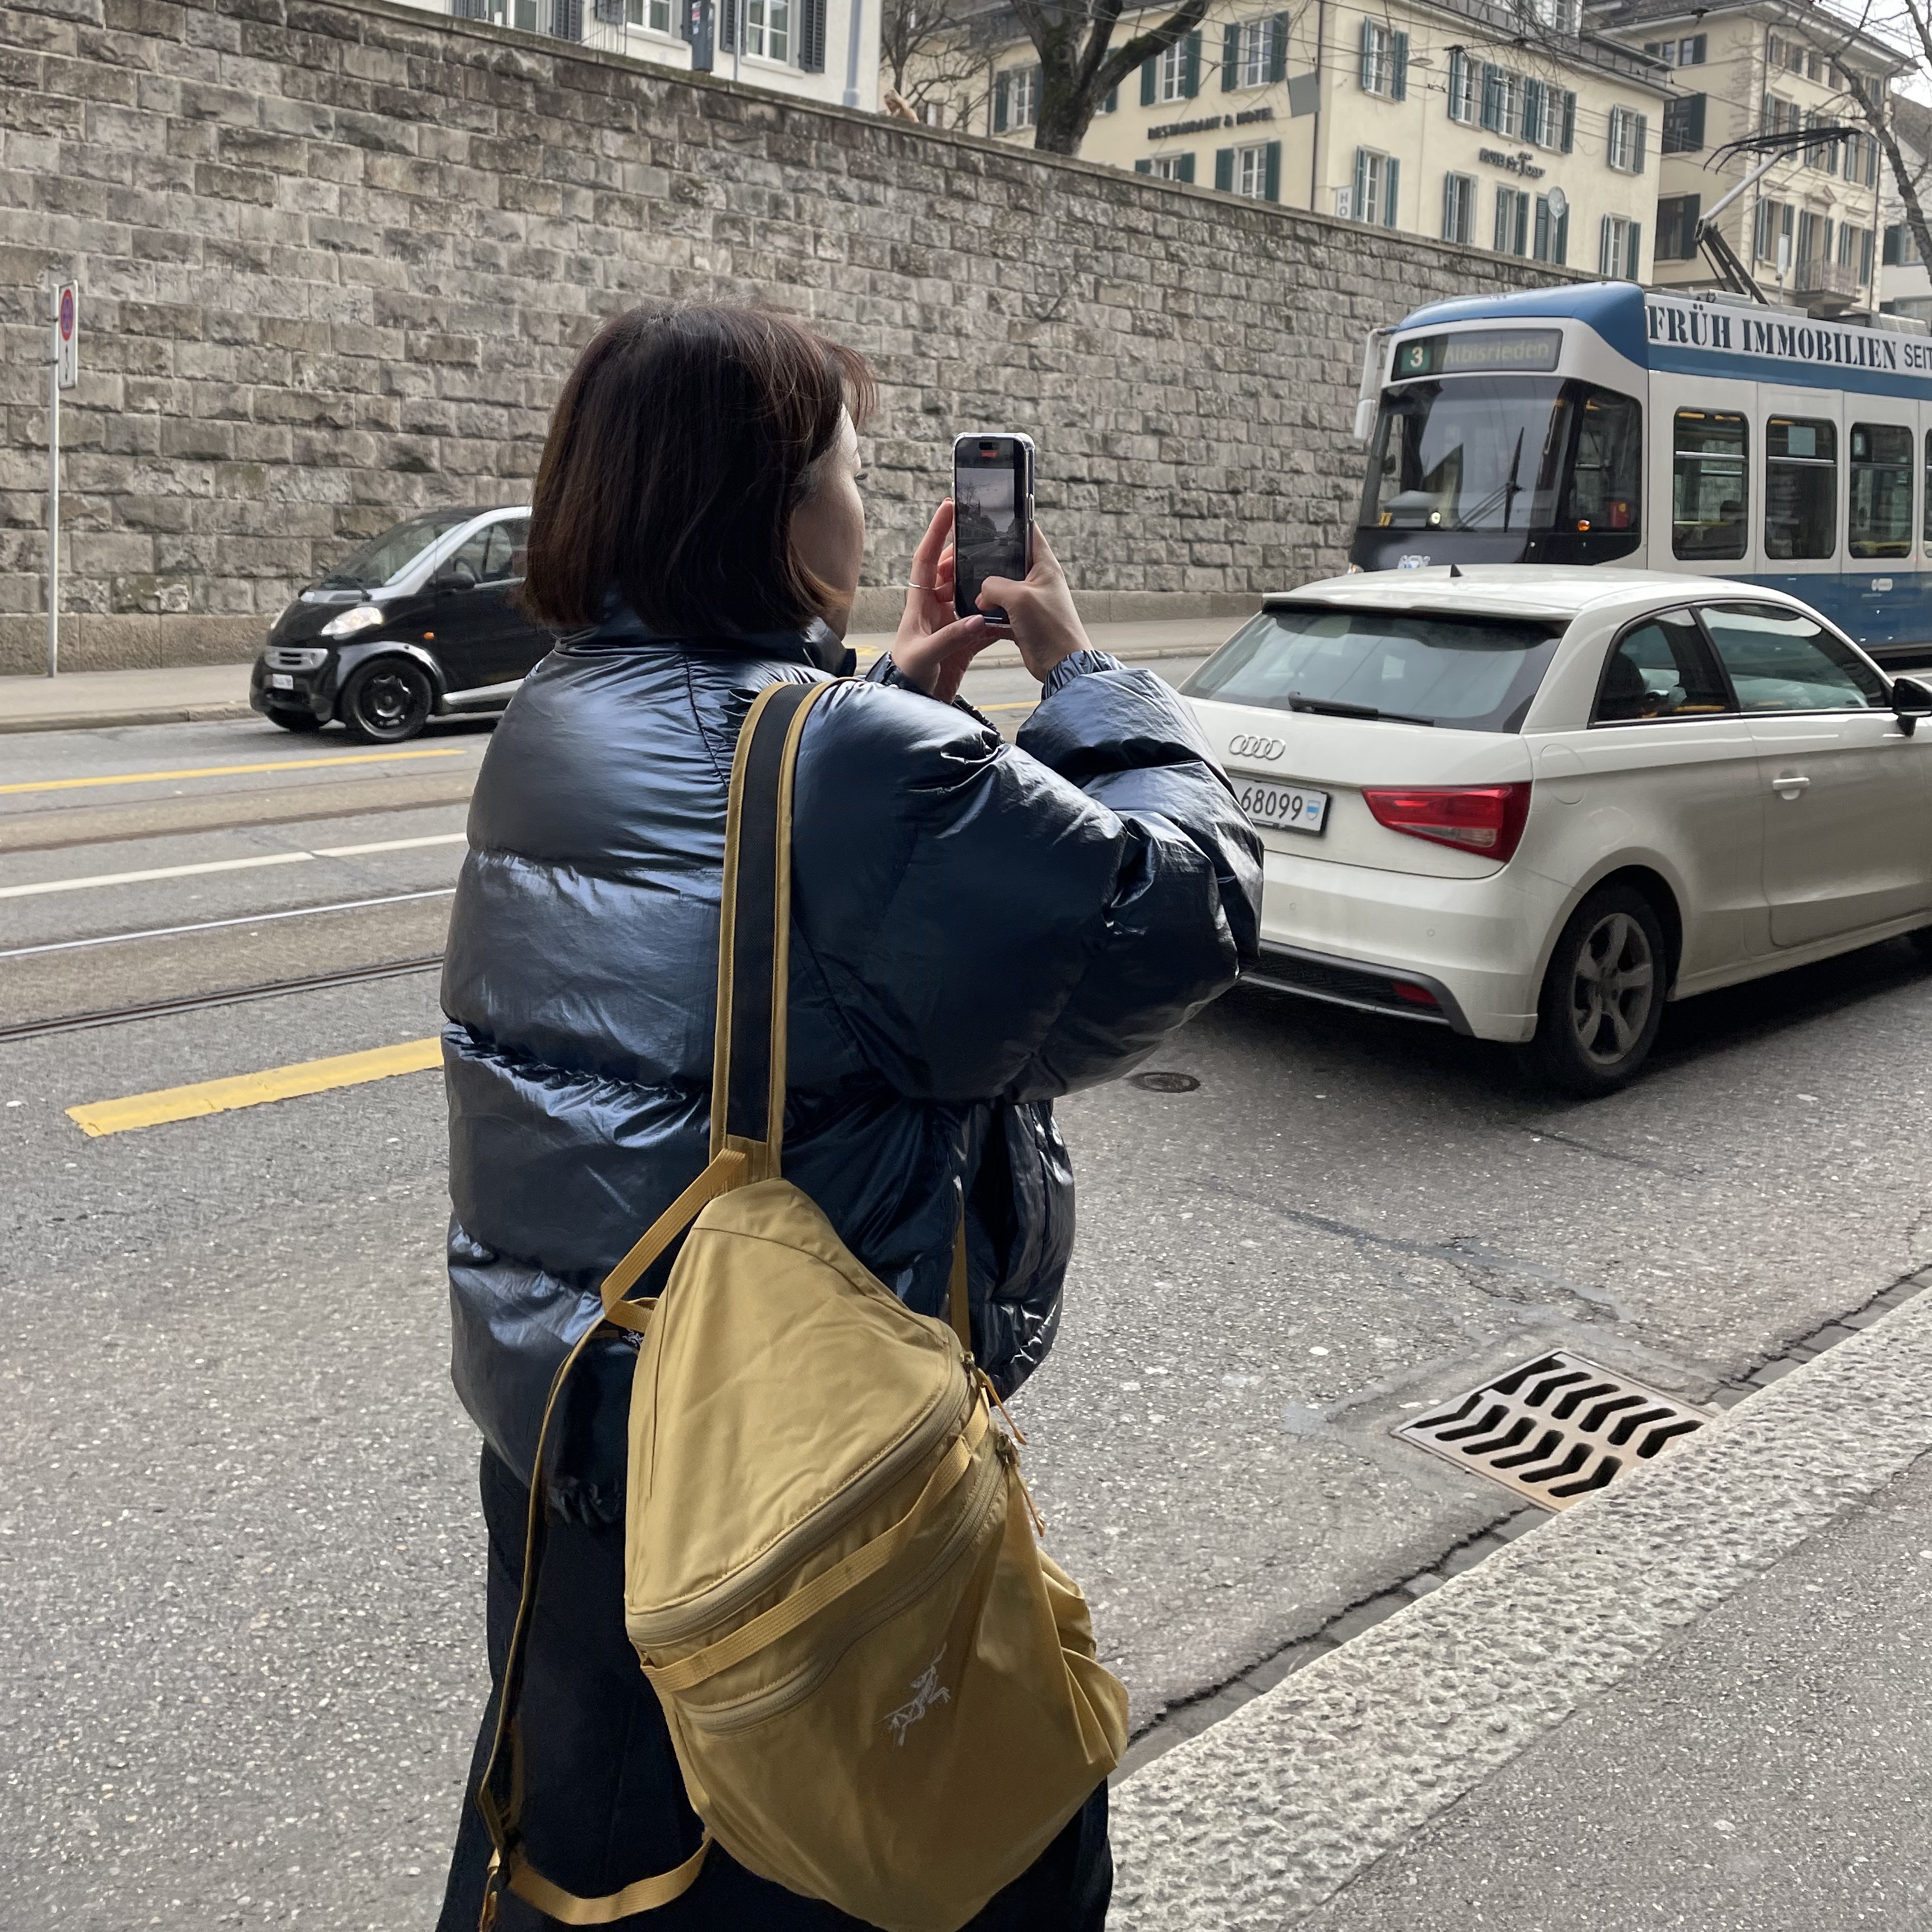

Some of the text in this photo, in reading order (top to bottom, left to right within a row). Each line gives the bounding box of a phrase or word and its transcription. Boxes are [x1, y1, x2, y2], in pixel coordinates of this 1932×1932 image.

[1410, 339, 1549, 368] 3 Albisrieden
[1647, 303, 1932, 371] FRÜH IMMOBILIEN SEIT
[1241, 786, 1303, 821] 68099
